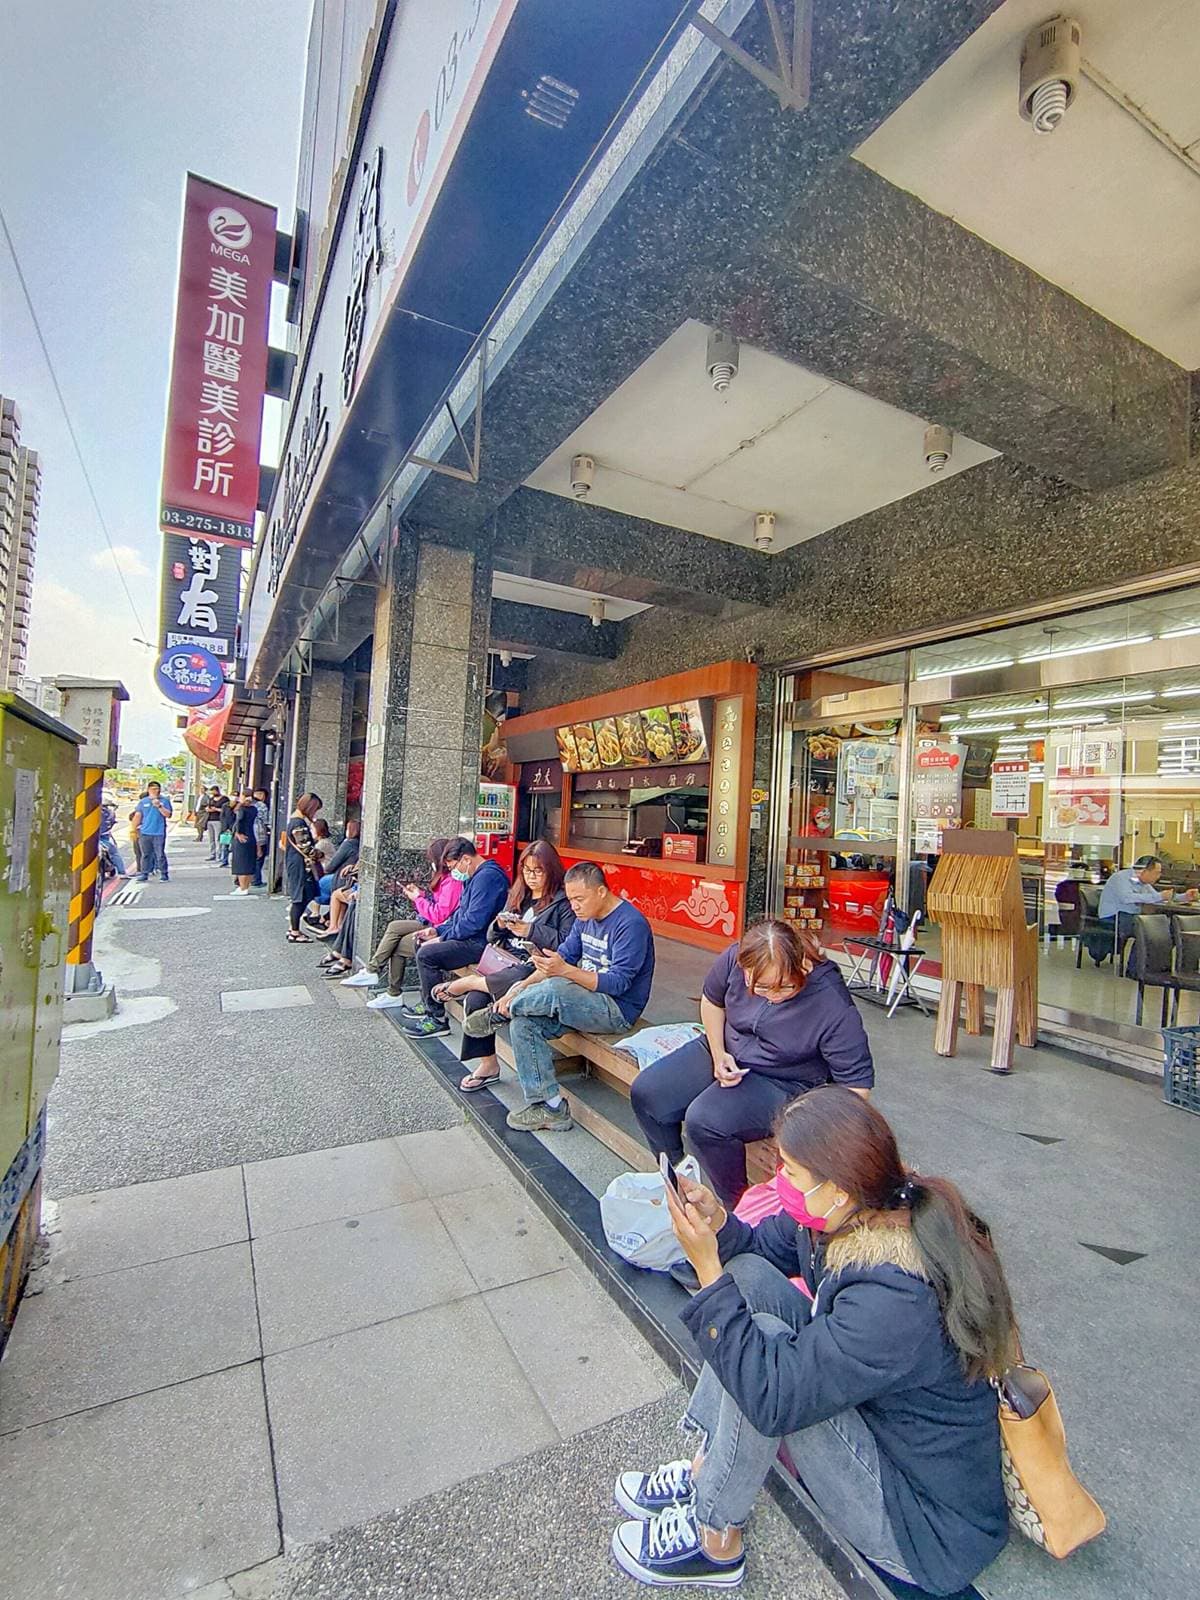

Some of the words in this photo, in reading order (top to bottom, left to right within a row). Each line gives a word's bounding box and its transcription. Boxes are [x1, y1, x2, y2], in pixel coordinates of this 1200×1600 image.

[210, 243, 251, 265] MEGA
[193, 266, 248, 497] 美加醫美診所
[161, 511, 252, 538] 03-275-1313
